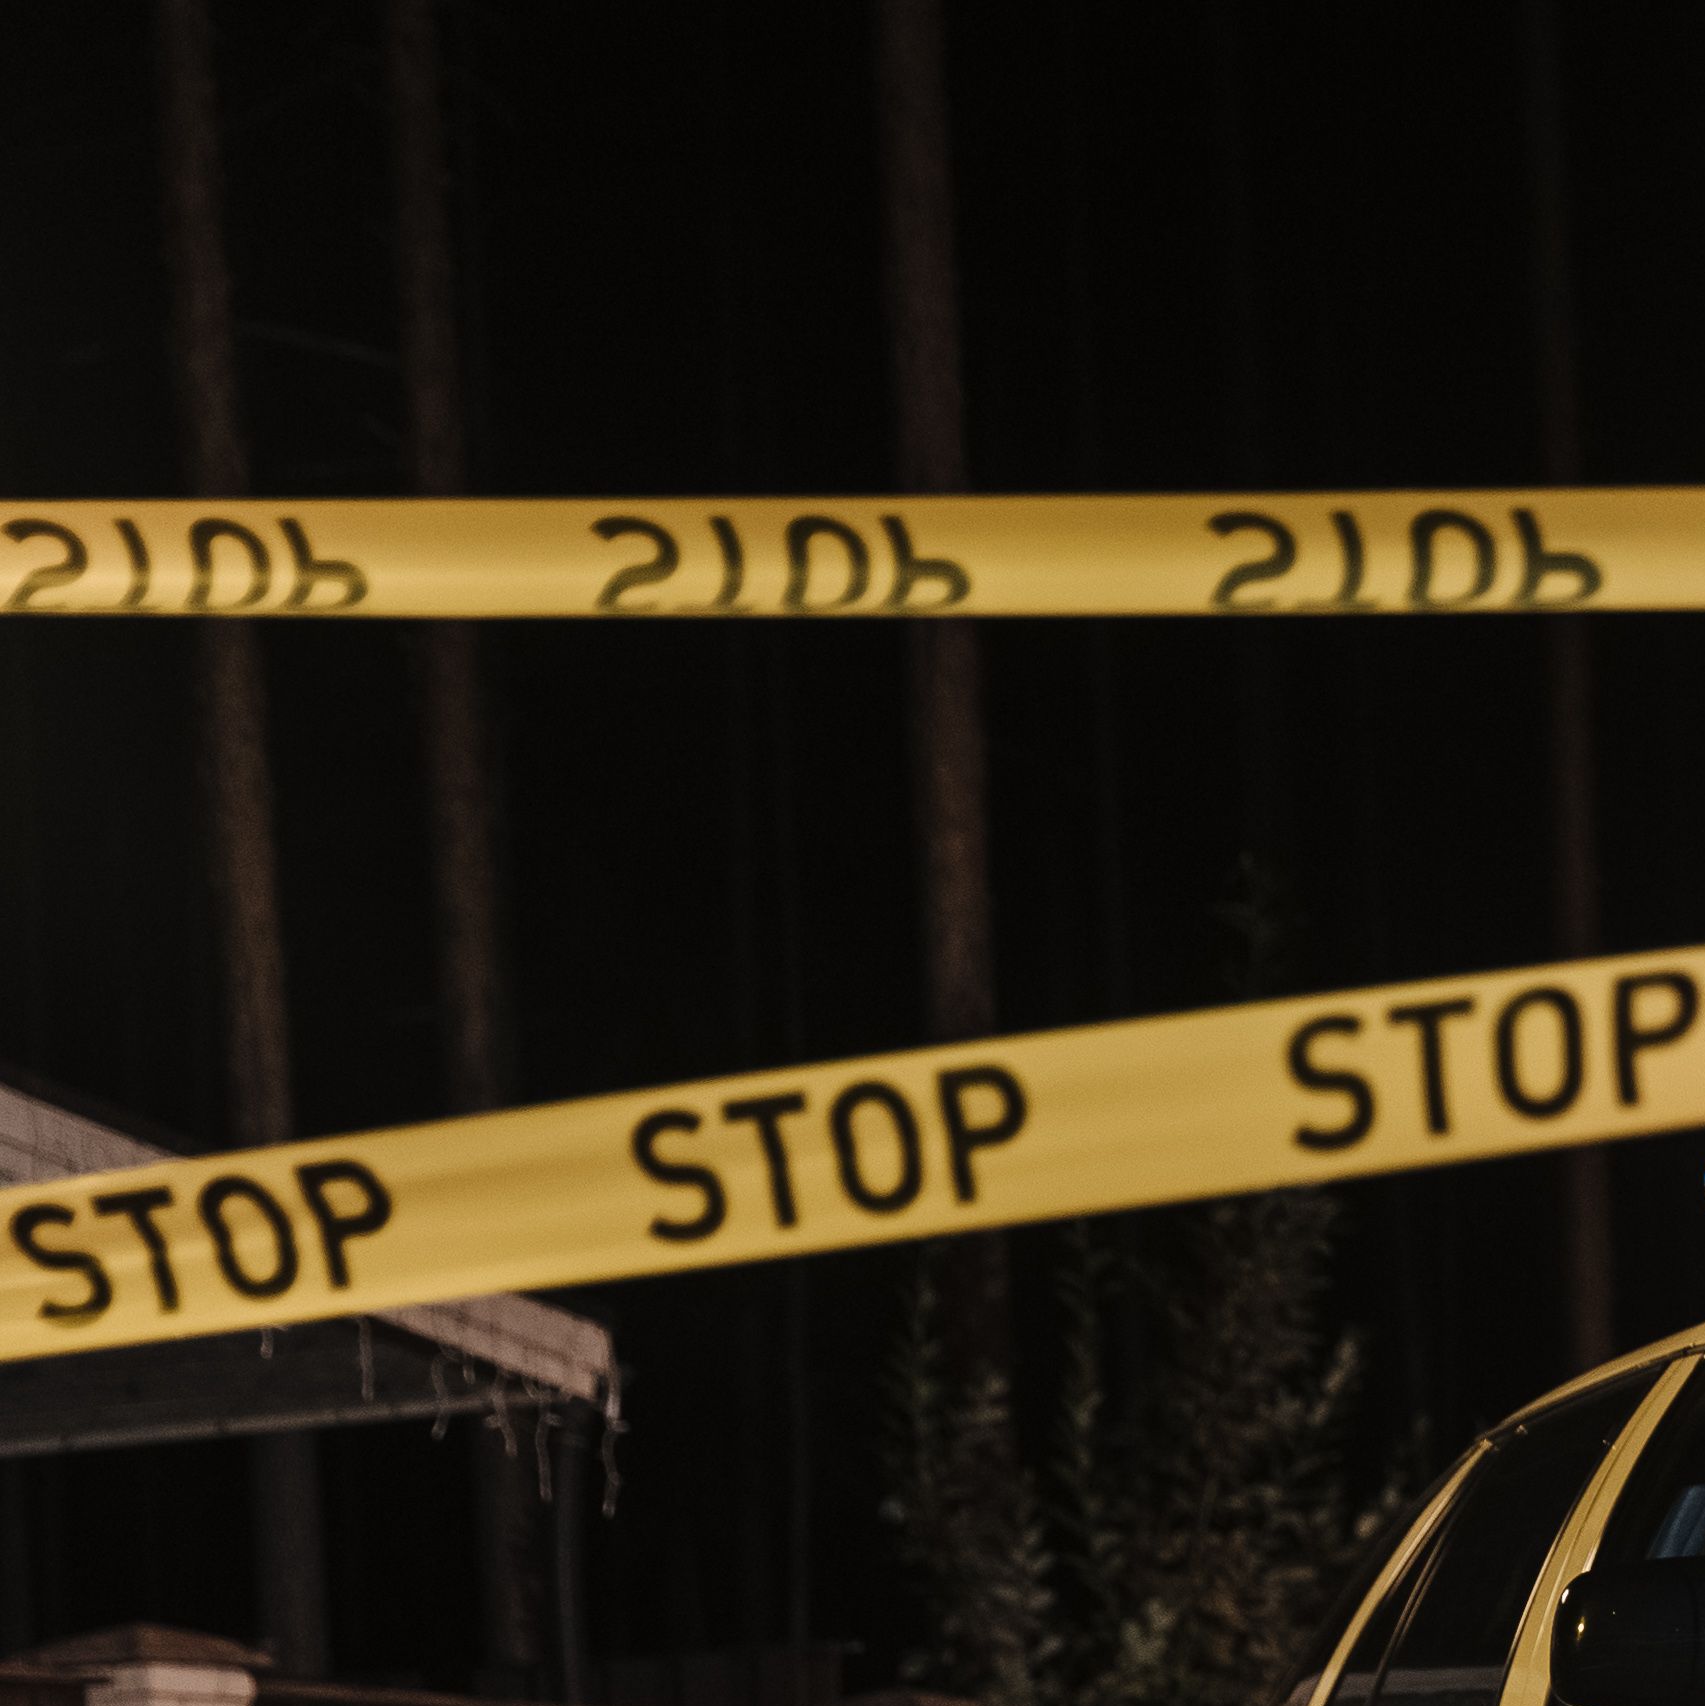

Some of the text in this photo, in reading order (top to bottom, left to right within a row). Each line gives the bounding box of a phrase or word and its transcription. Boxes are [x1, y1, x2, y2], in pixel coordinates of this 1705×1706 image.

[10, 1158, 392, 1326] STOP
[630, 1063, 1028, 1241] STOP
[1286, 968, 1703, 1151] STOP
